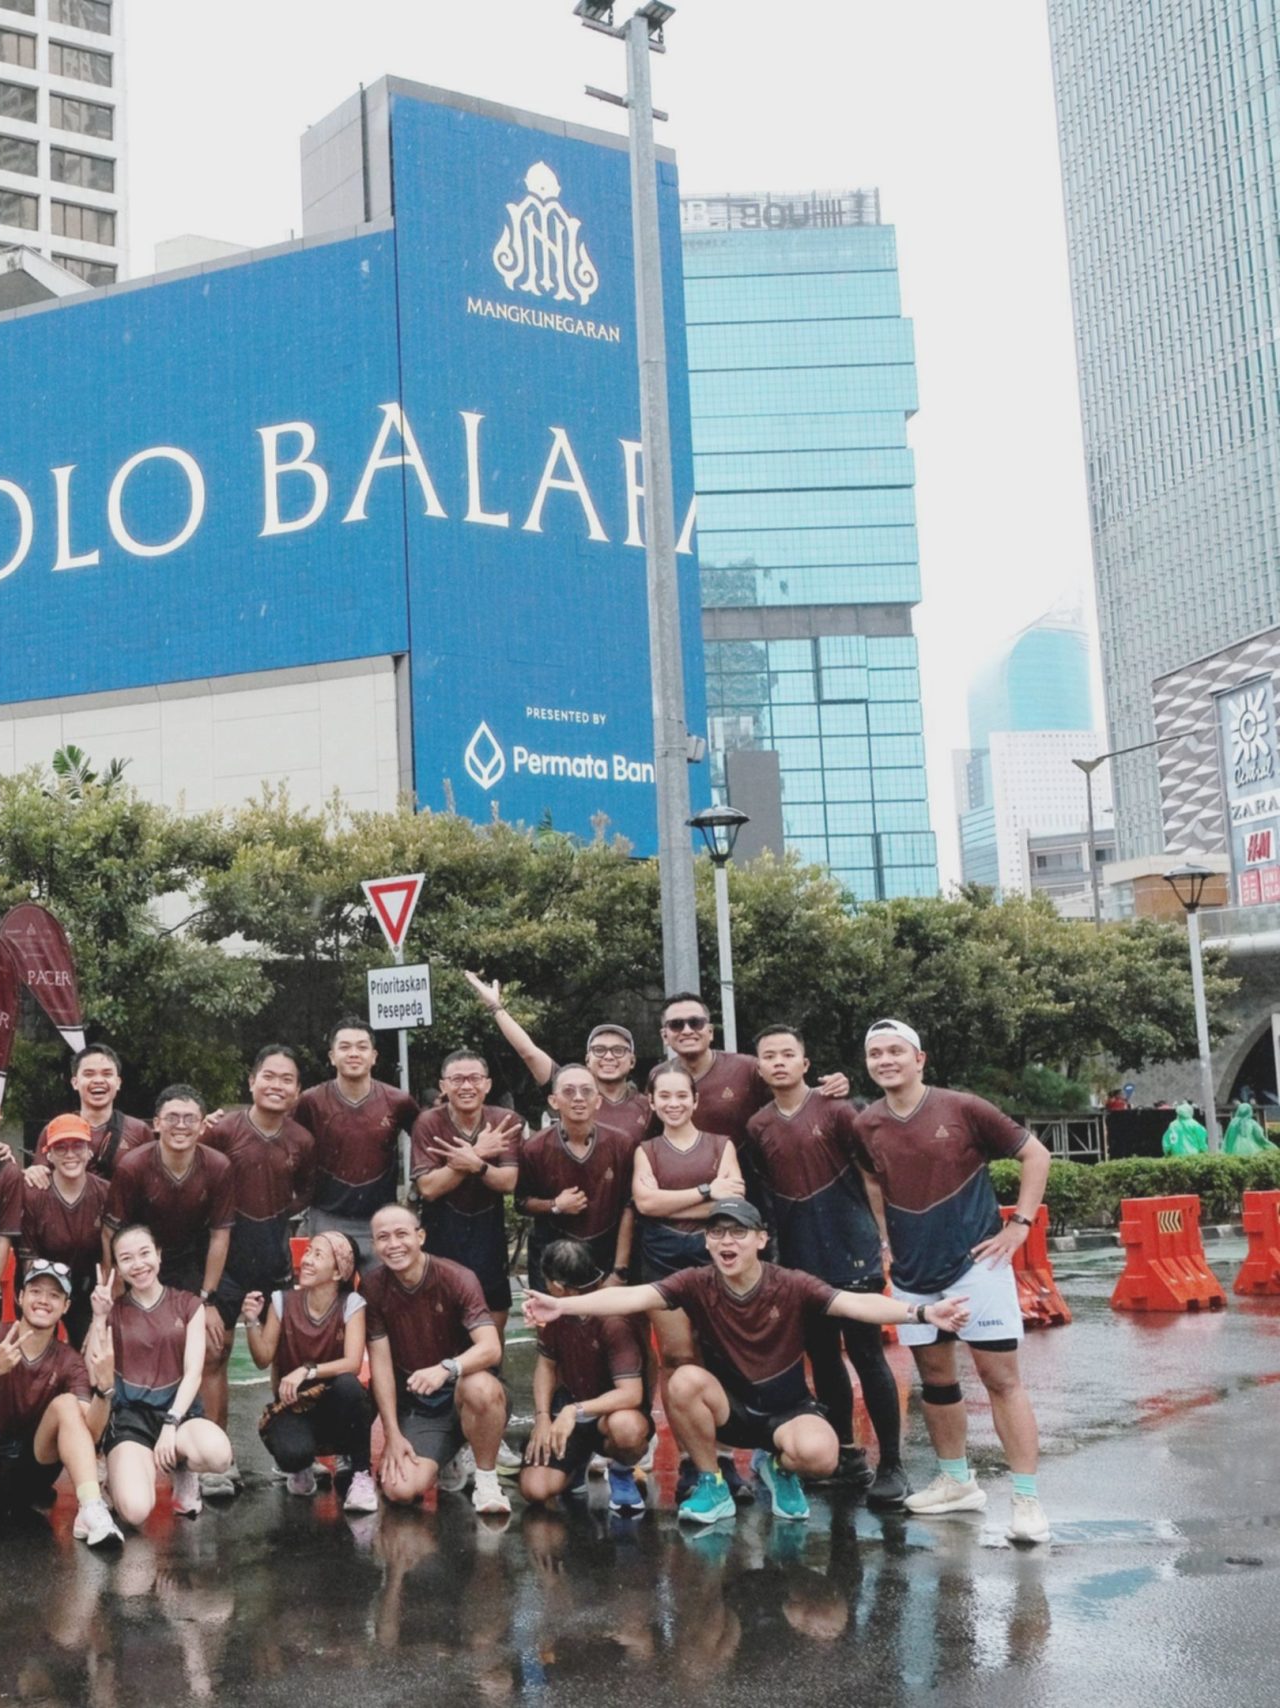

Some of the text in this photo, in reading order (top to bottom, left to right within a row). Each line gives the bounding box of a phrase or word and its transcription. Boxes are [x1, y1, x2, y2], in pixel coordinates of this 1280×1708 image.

[467, 296, 620, 343] MANGKUNEGARAN
[526, 706, 607, 725] PRESENTED BY
[513, 746, 655, 784] Permata Ban
[1231, 796, 1280, 820] ZARA
[27, 969, 72, 987] PACER
[370, 976, 428, 995] Prioritaskan
[377, 1000, 423, 1021] Pesepeda
